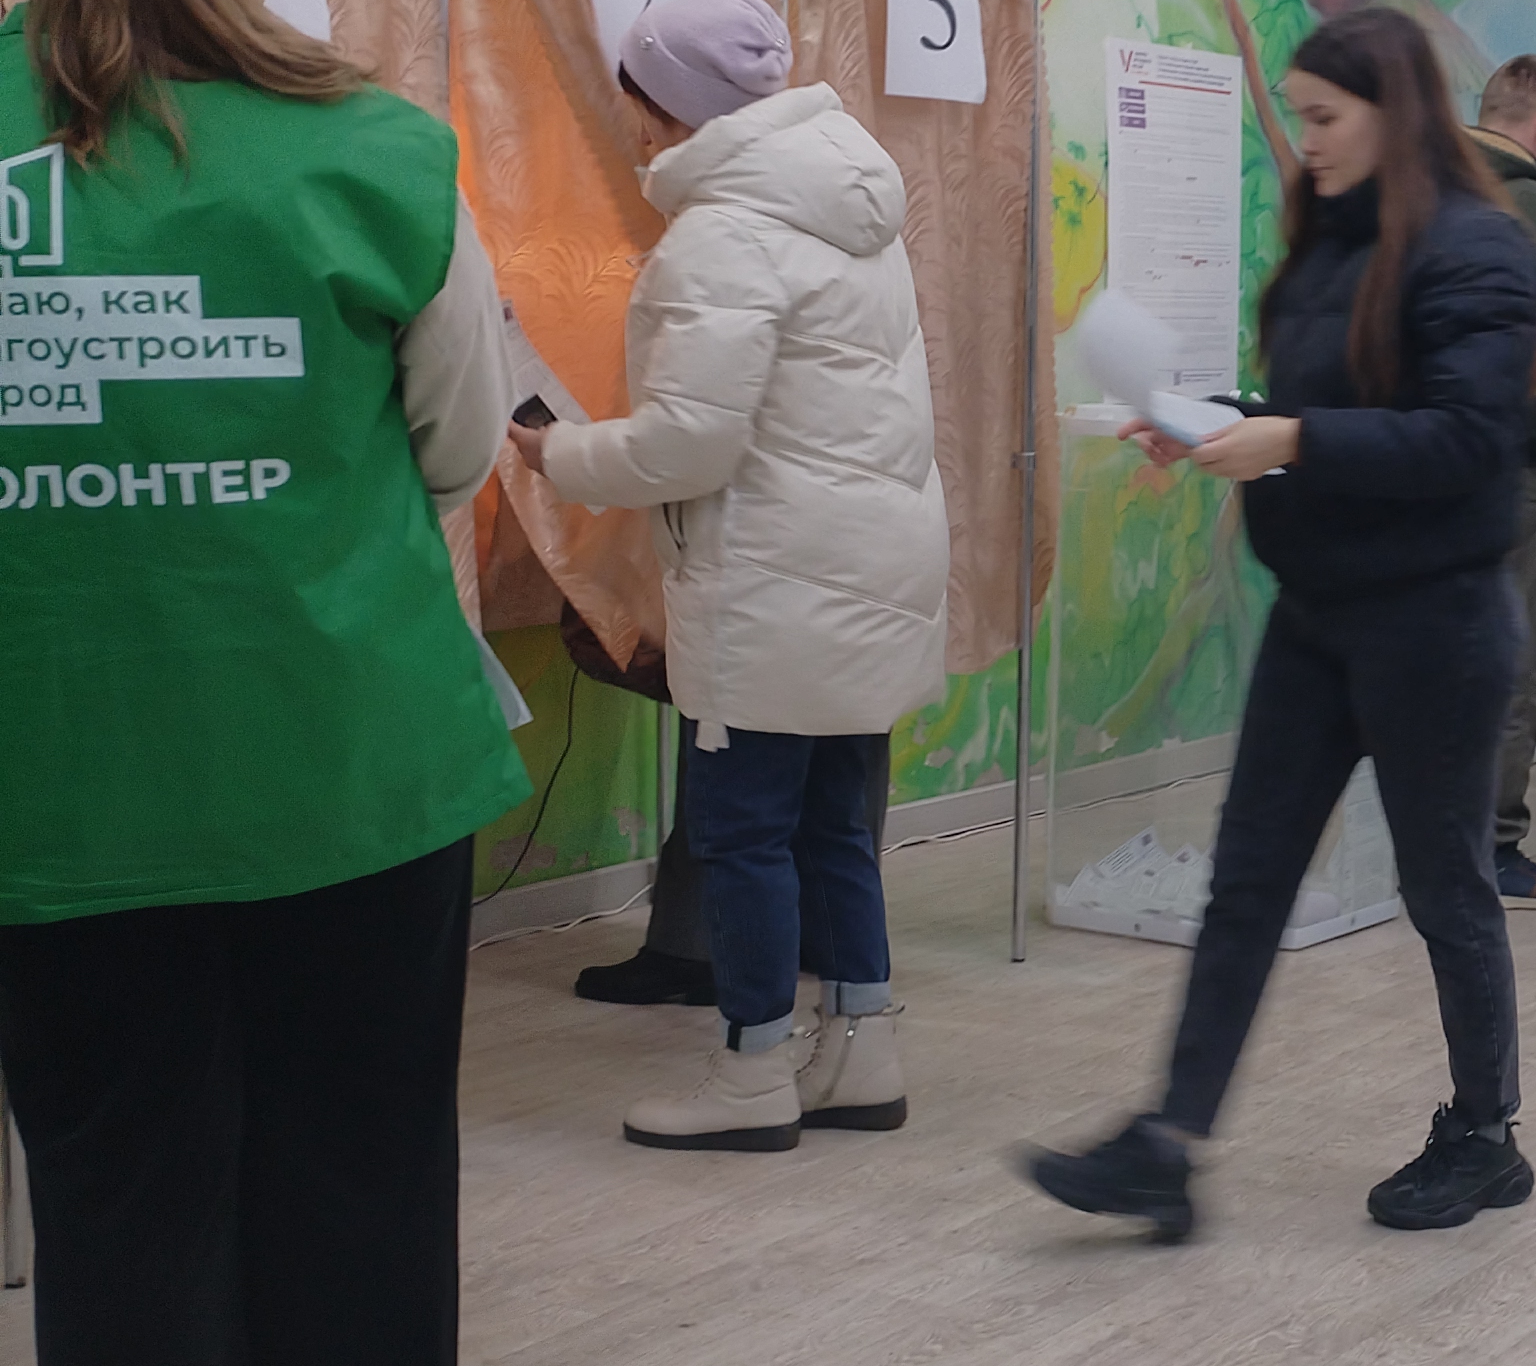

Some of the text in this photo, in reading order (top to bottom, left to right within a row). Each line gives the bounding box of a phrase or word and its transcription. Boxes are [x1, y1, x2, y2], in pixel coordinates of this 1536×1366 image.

[0, 289, 191, 321] аю, как
[0, 334, 288, 369] гоустроить
[0, 382, 88, 415] род
